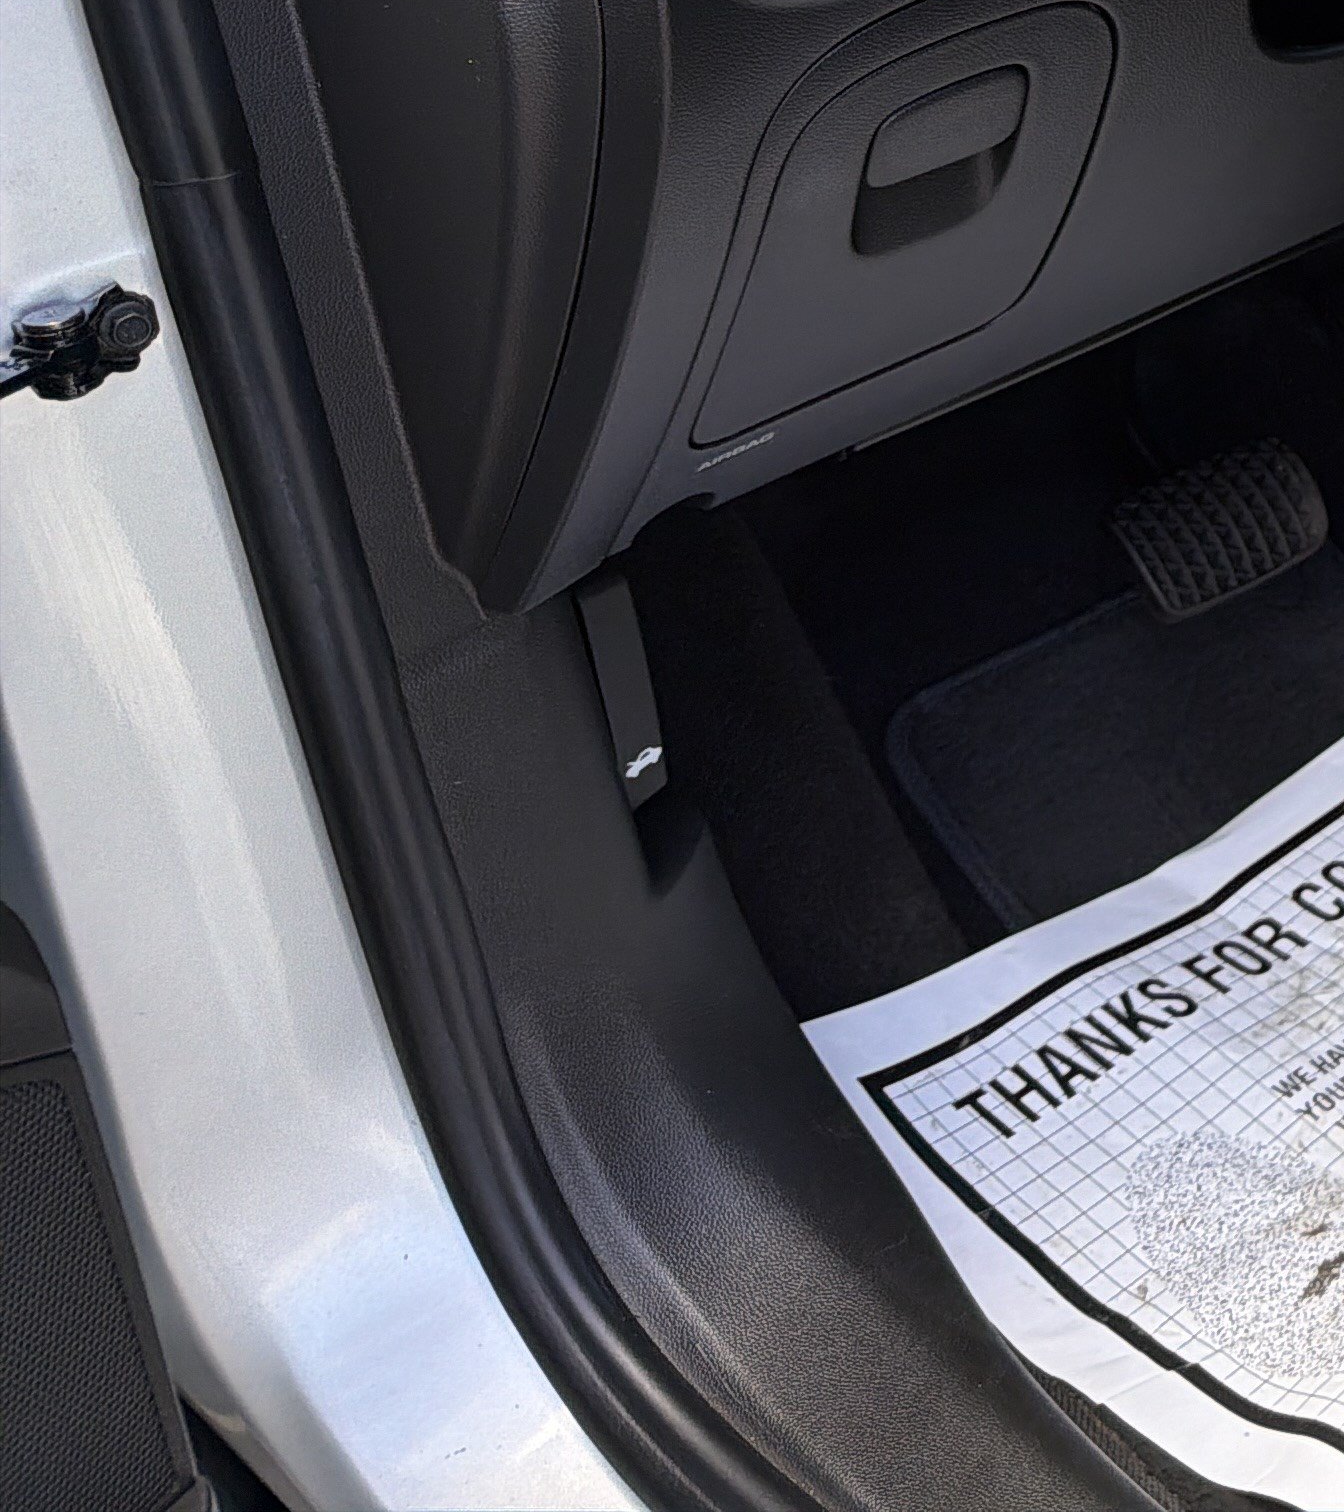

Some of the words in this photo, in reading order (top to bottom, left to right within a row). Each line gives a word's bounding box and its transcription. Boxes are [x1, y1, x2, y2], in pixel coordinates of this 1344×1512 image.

[697, 431, 776, 472] AIRBAG
[951, 976, 1199, 1139] THANKS
[1182, 916, 1309, 995] FOR
[1271, 1065, 1313, 1100] WE
